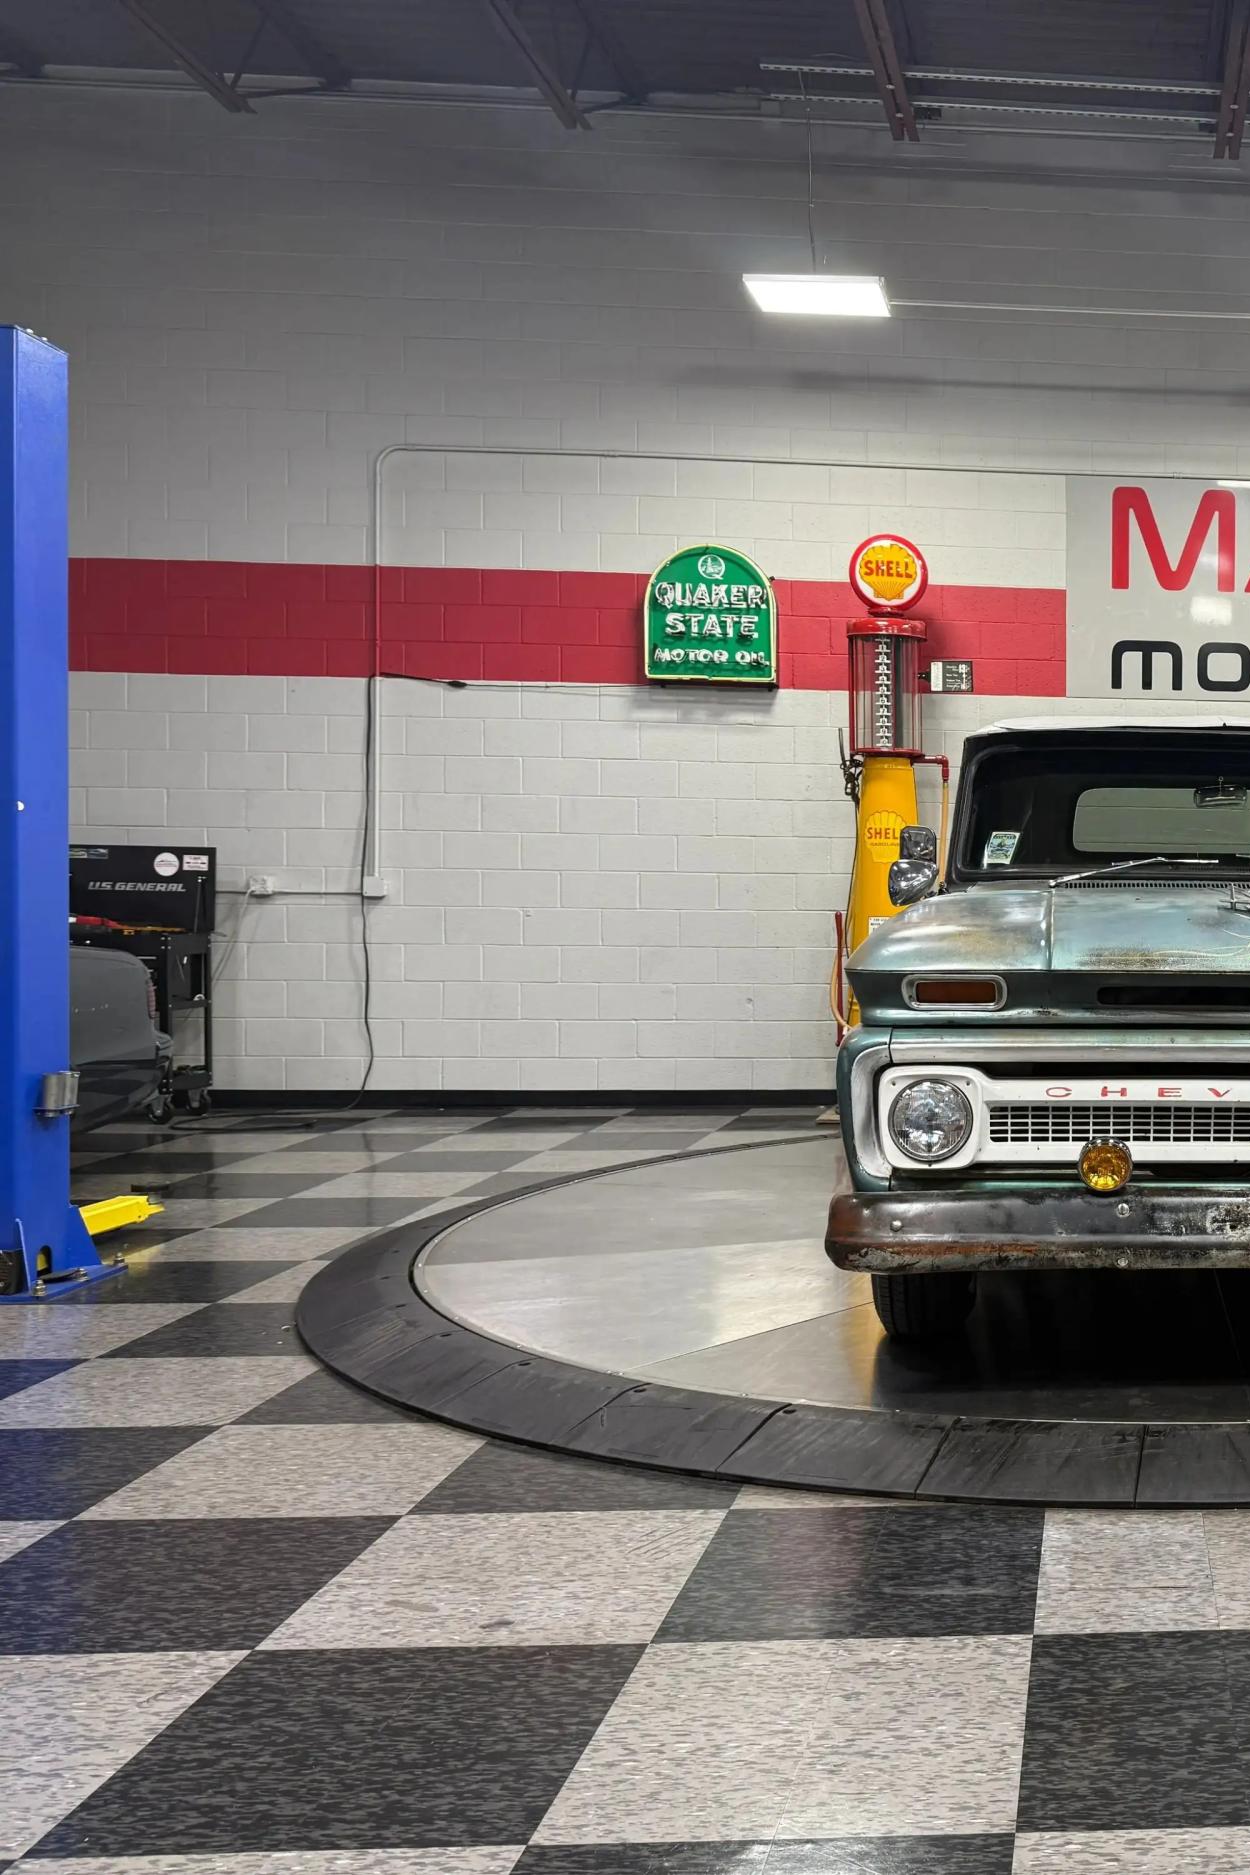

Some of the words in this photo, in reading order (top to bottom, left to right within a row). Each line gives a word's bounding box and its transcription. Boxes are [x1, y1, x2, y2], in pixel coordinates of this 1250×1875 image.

[863, 559, 913, 579] SHELL
[655, 581, 768, 609] QUAKER
[665, 612, 759, 639] STATE
[654, 648, 729, 664] MOTOR
[735, 650, 770, 666] OIL
[867, 826, 899, 840] SHEL
[114, 882, 187, 893] GENERAL
